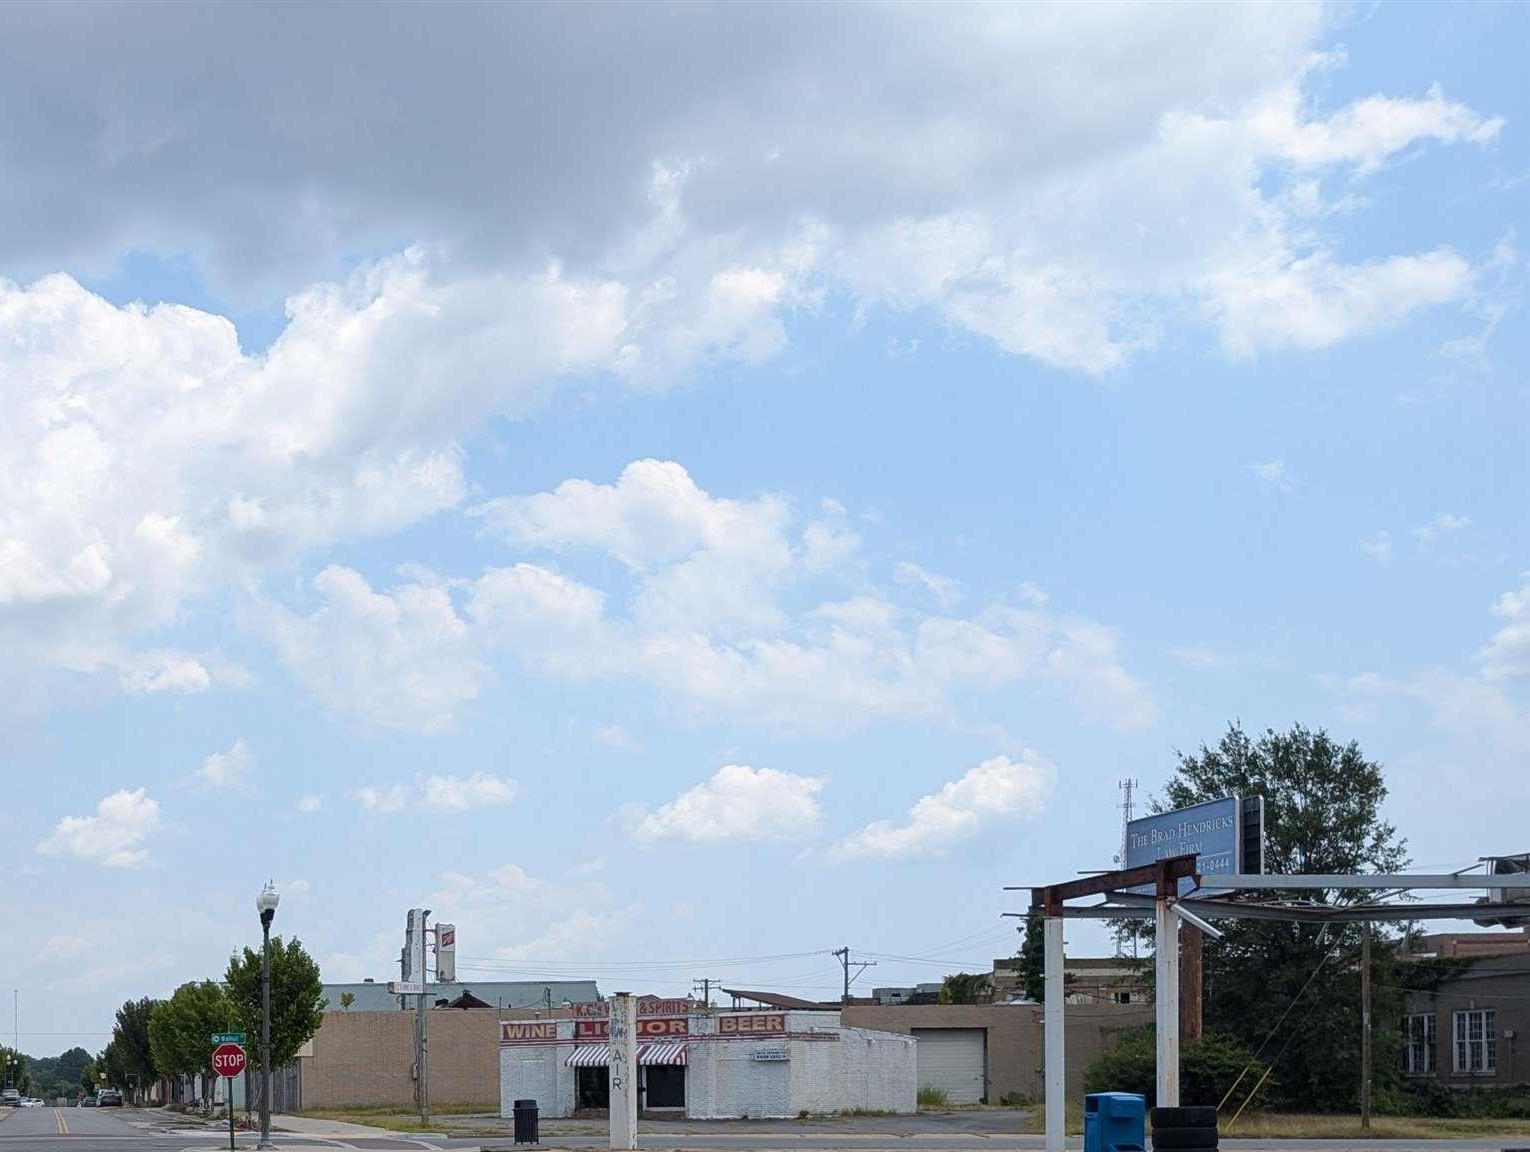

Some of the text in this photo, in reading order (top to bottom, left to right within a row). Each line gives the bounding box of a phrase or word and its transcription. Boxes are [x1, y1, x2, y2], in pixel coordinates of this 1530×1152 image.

[1131, 816, 1234, 849] THE BRAD HENDRICKS
[1180, 841, 1204, 856] FIRM
[649, 1001, 690, 1014] SPIRITS
[721, 1015, 783, 1032] BEER
[507, 1025, 557, 1040] WINE
[215, 1054, 244, 1068] STOP
[612, 1048, 623, 1091] AIR
